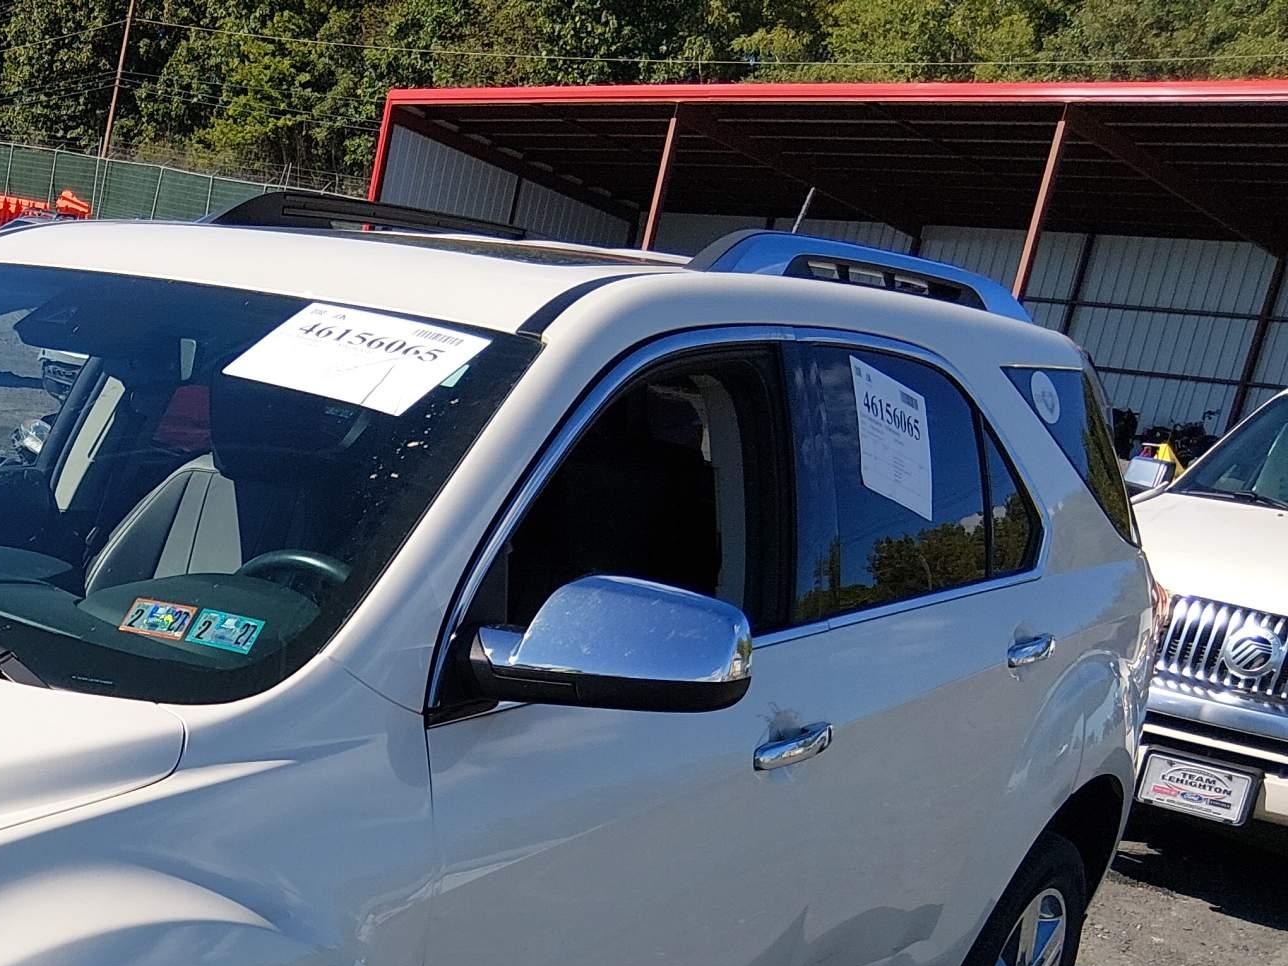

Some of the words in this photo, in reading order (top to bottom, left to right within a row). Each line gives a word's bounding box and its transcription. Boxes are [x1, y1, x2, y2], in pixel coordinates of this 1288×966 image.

[299, 322, 446, 362] 46156065
[863, 391, 921, 441] 46156065
[196, 620, 212, 639] 2
[233, 622, 258, 645] 27
[1161, 774, 1232, 796] LEHIGHTON
[1181, 772, 1217, 785] TEAM
